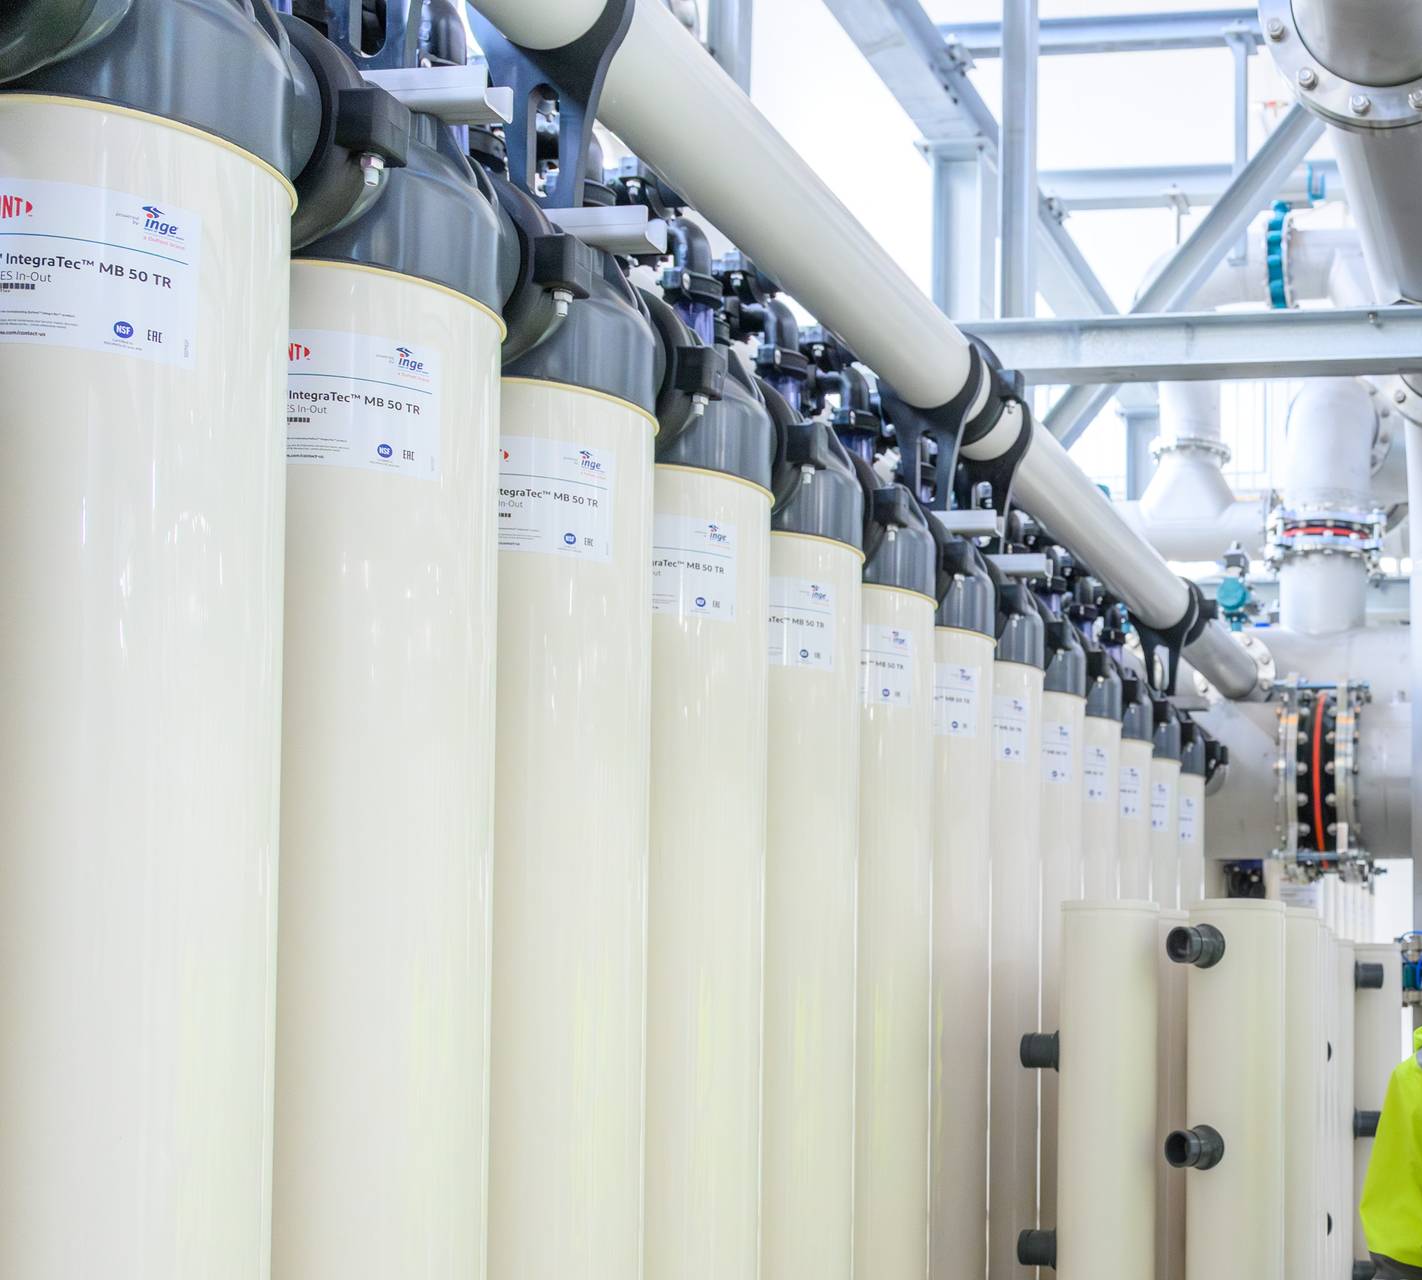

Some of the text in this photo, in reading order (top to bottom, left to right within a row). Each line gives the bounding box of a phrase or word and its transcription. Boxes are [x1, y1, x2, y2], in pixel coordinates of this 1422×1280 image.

[145, 218, 178, 235] inge
[15, 271, 52, 283] In-Out
[99, 262, 125, 277] MB
[129, 268, 148, 282] 50
[153, 273, 172, 289] TR
[398, 357, 424, 371] inge
[297, 404, 327, 414] In-Out
[364, 396, 384, 407] MB
[387, 400, 402, 411] 50
[406, 403, 420, 415] TR
[580, 459, 601, 471] inge
[553, 492, 570, 502] MB
[572, 496, 584, 505] 50
[587, 498, 599, 508] TR
